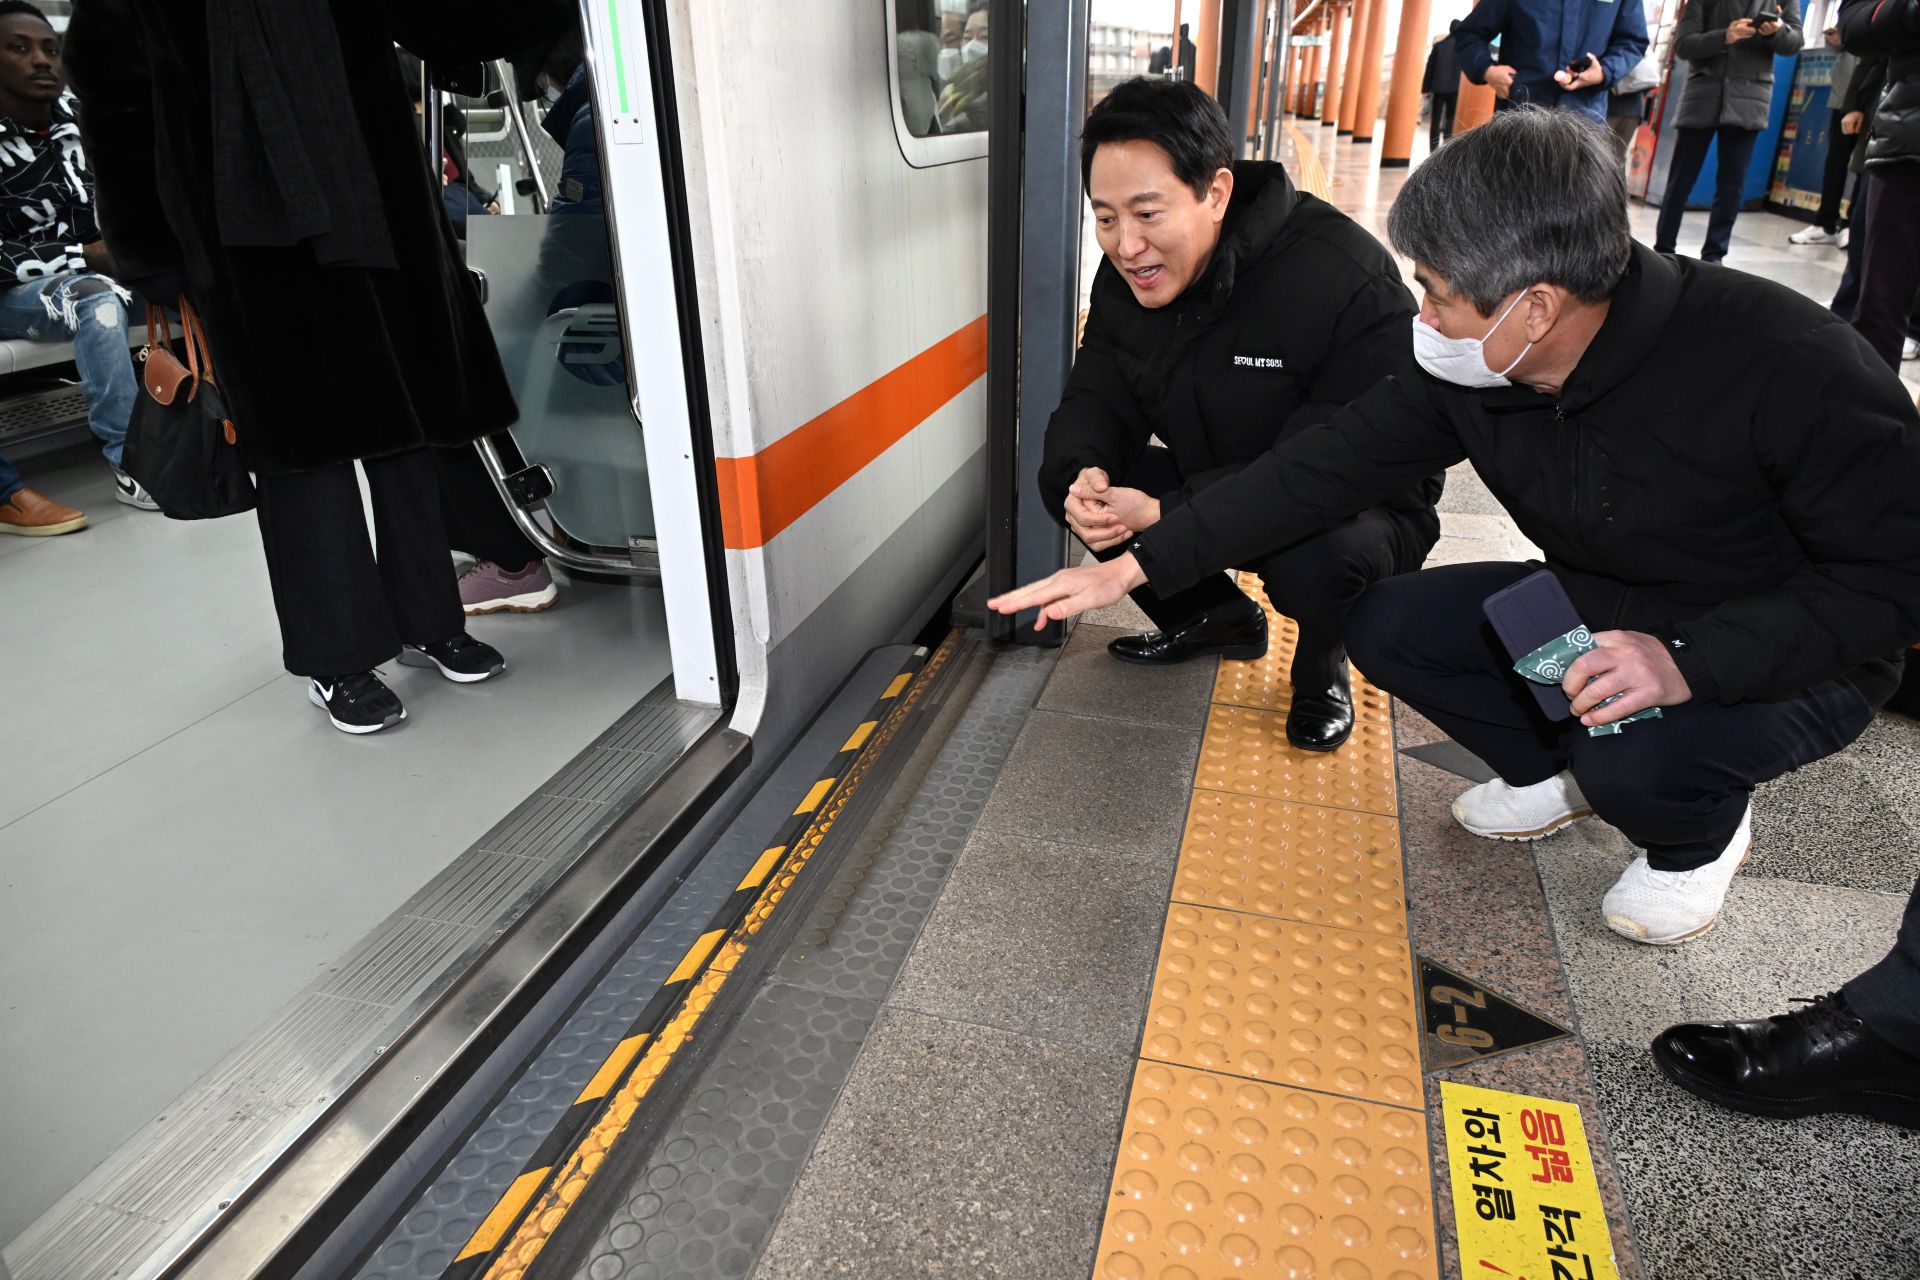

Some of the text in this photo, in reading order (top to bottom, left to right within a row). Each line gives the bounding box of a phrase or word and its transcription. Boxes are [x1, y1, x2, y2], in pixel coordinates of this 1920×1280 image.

[1233, 355, 1254, 366] SEOUL
[1254, 357, 1265, 368] MY
[1430, 985, 1494, 1049] 6-2
[1461, 1107, 1516, 1221] 열차와
[1519, 1109, 1574, 1184] 넓음
